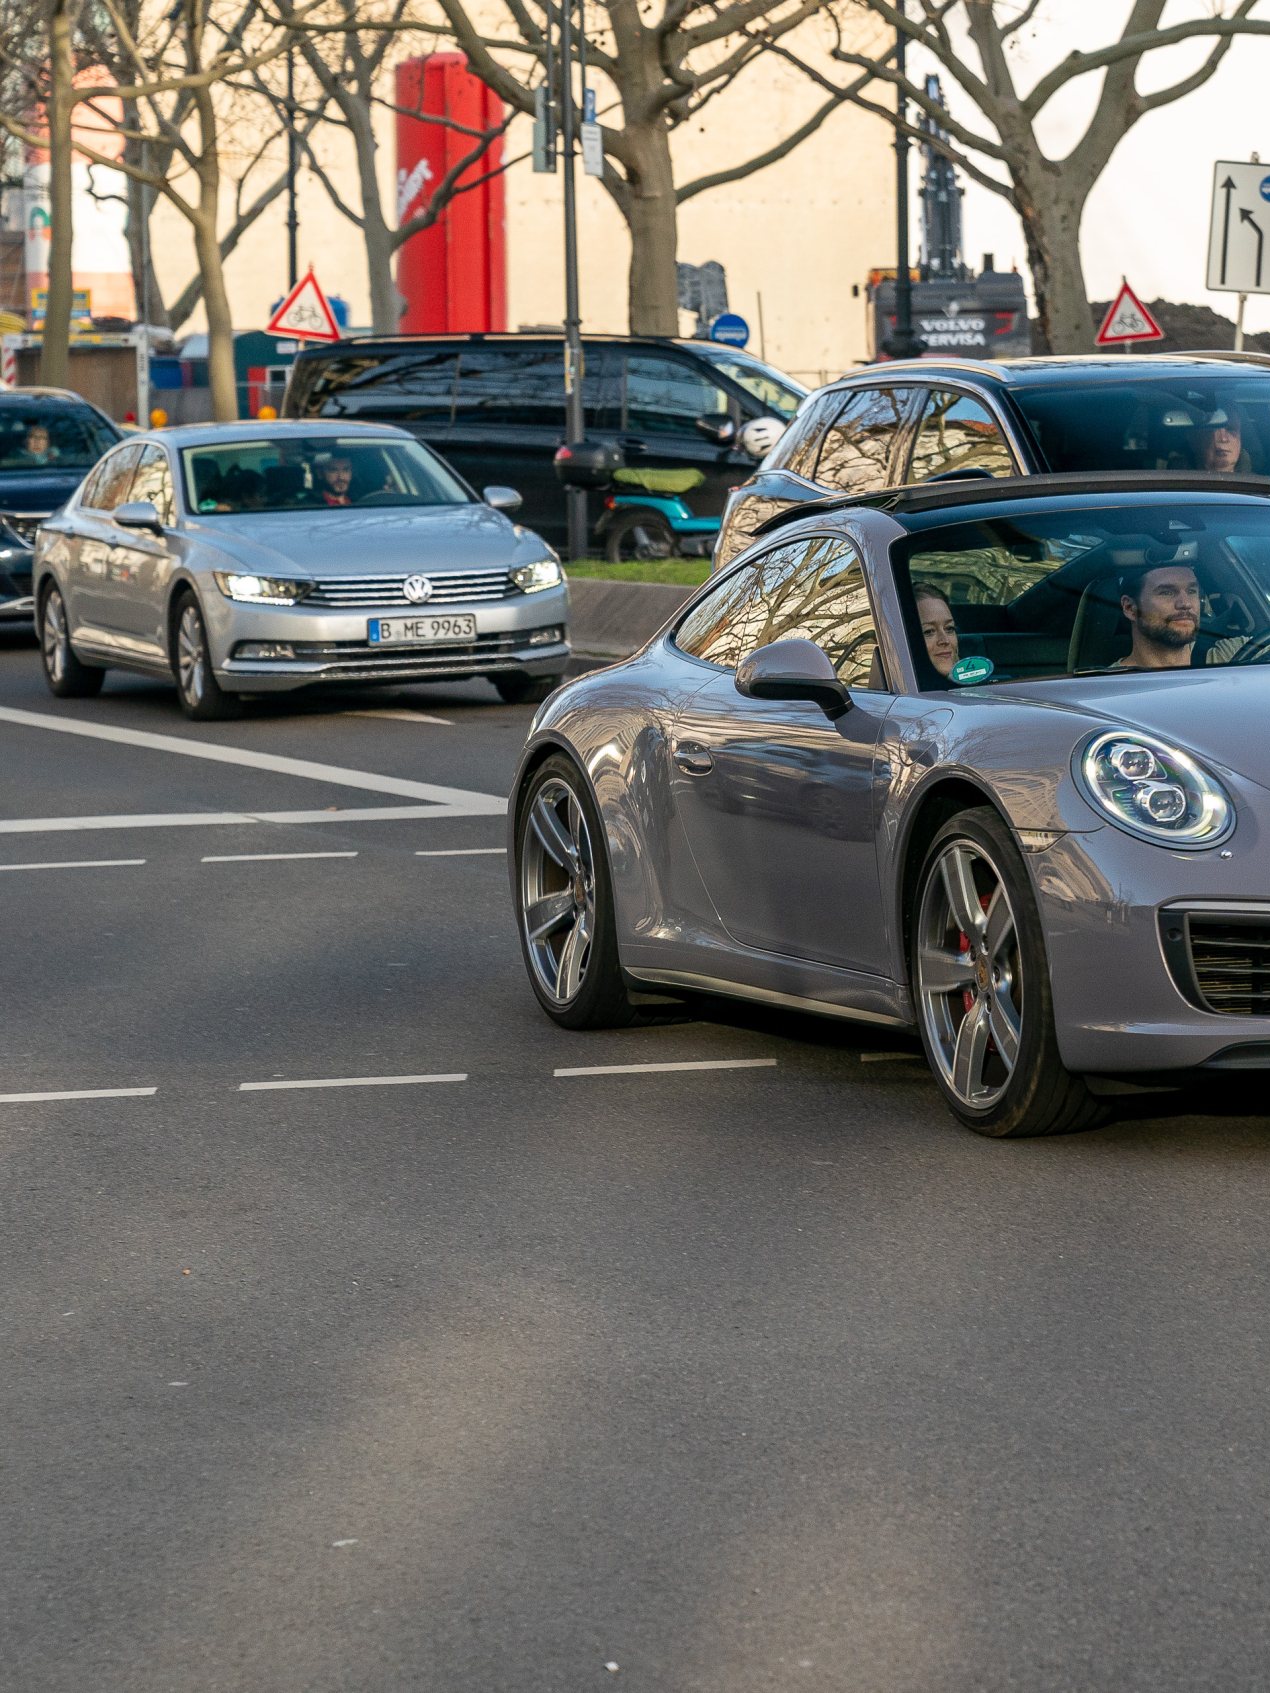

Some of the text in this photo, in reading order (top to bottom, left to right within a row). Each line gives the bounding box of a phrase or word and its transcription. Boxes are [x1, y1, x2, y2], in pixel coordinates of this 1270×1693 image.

[920, 319, 985, 331] VOLVO
[380, 618, 472, 639] B ME 9963
